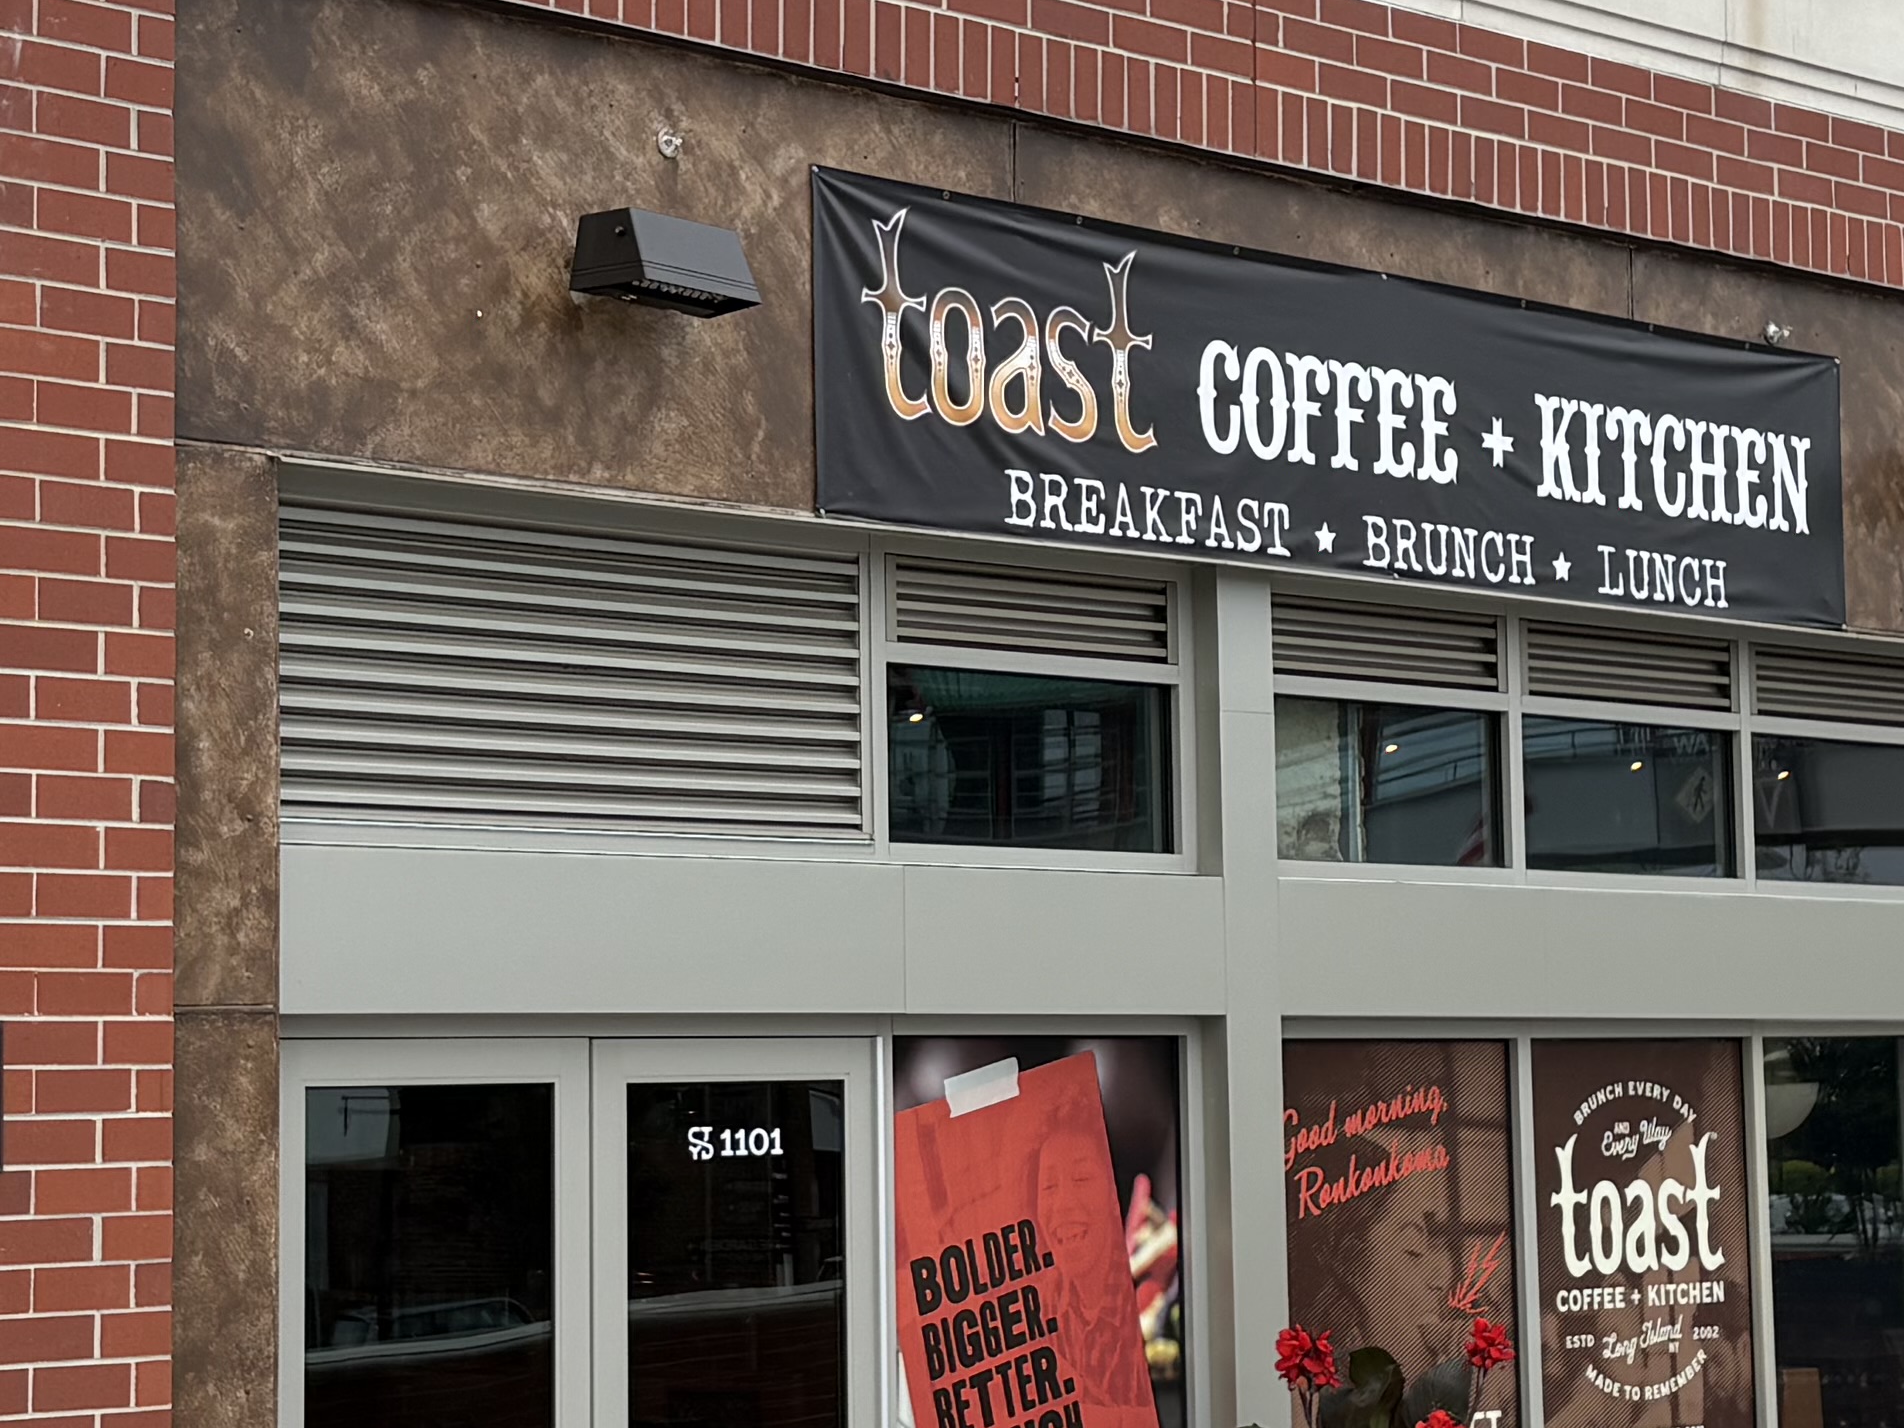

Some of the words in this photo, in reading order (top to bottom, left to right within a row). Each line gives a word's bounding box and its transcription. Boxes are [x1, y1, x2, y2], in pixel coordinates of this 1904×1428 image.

[861, 206, 1158, 453] toast
[1197, 338, 1458, 484] COFFEE
[1534, 393, 1812, 534] KITCHEN
[1004, 470, 1291, 557] BREAKFAST
[1362, 514, 1536, 585] BRUNCH
[1597, 545, 1728, 608] LUNCH
[1283, 1100, 1337, 1170] Good
[1344, 1085, 1448, 1126] morning,
[1573, 1082, 1623, 1126] BRUNCH
[1628, 1081, 1670, 1102] EVERY
[1673, 1095, 1697, 1123] DAY
[1614, 1122, 1630, 1134] AND
[720, 1127, 784, 1157] 1101
[1601, 1131, 1639, 1160] Every
[1640, 1117, 1672, 1151] Way
[1294, 1138, 1449, 1219] Ronkonkoma
[1550, 1132, 1725, 1278] toast
[909, 1219, 1054, 1316] BOLDER.
[1556, 1286, 1626, 1312] COFFEE
[1648, 1280, 1725, 1306] KITCHEN
[921, 1285, 1059, 1381] BIGGER.
[1565, 1334, 1595, 1349] ESTD
[1602, 1332, 1638, 1365] Long
[1640, 1314, 1683, 1348] Island
[1585, 1363, 1621, 1397] MADE
[1623, 1385, 1641, 1401] TO
[1645, 1348, 1707, 1401] REMEMBER
